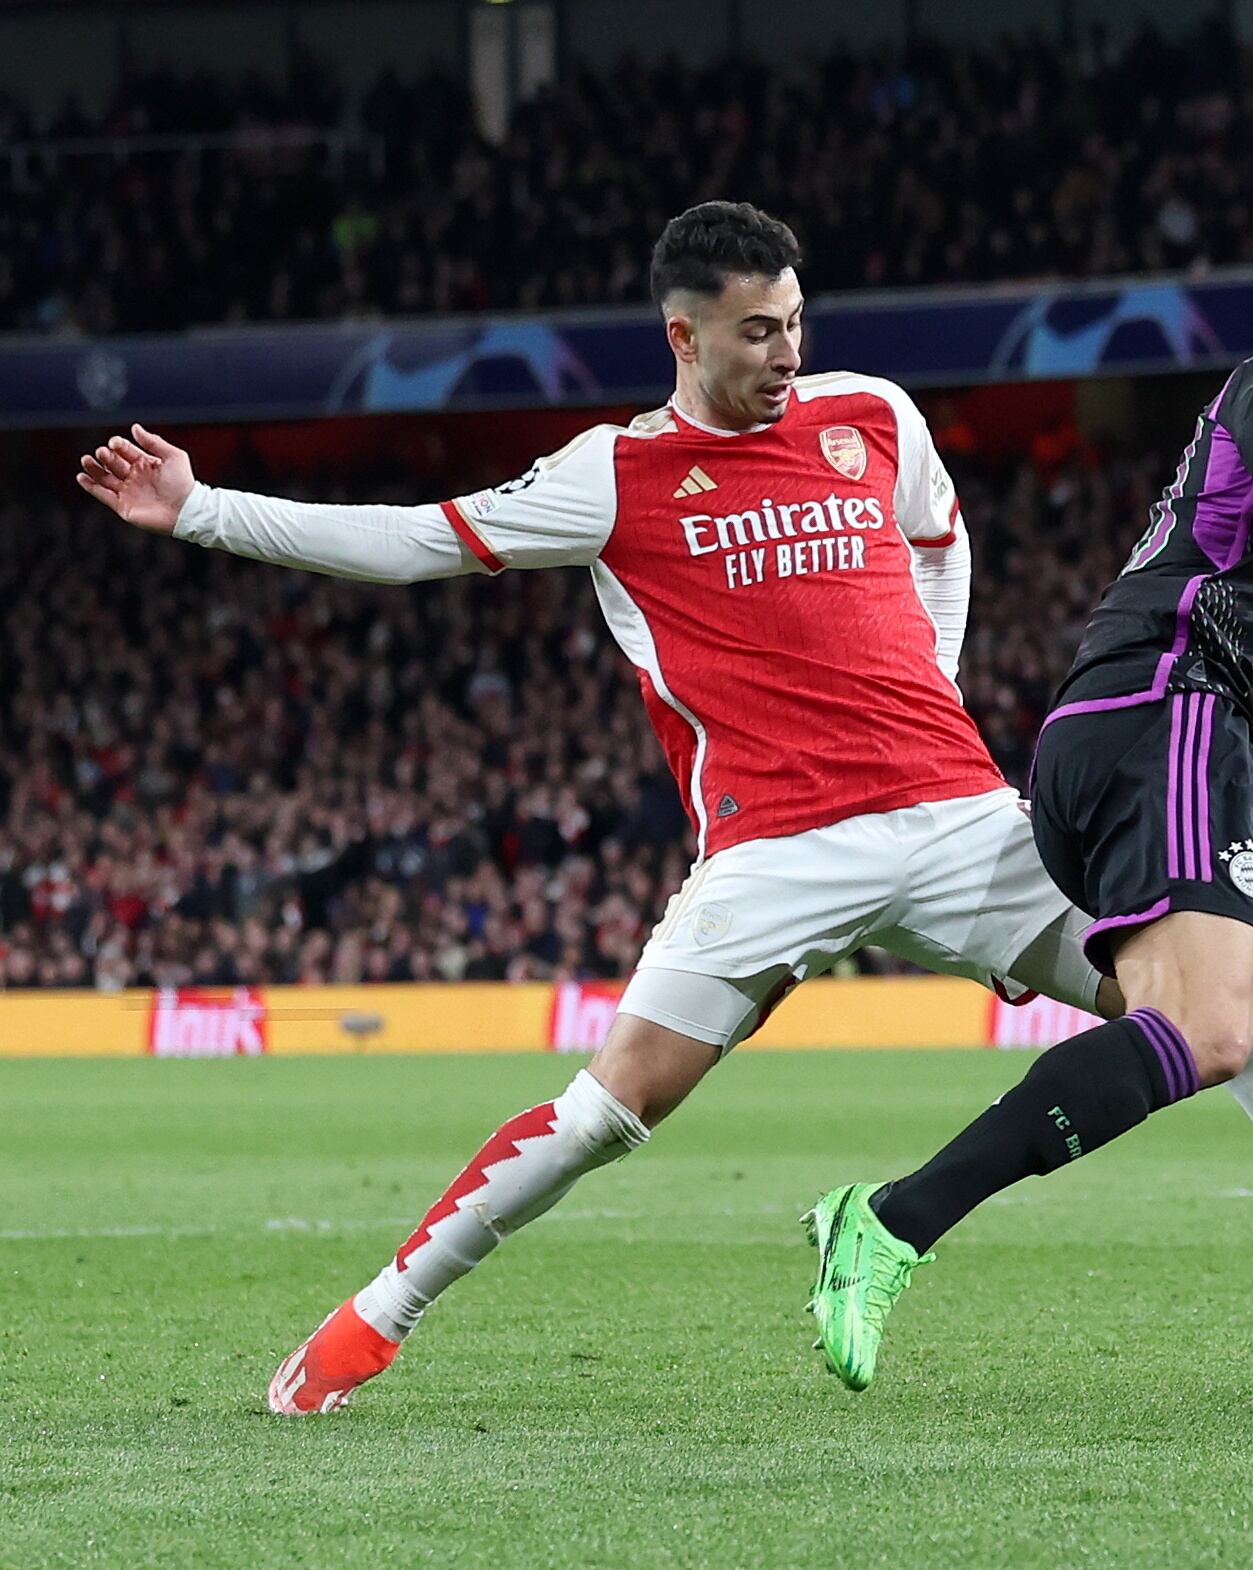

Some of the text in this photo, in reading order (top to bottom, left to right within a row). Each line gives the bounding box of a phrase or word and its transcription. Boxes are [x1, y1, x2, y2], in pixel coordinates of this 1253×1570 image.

[680, 492, 884, 556] Emirates
[725, 535, 865, 589] FLY BETTER
[1047, 1105, 1070, 1130] FC
